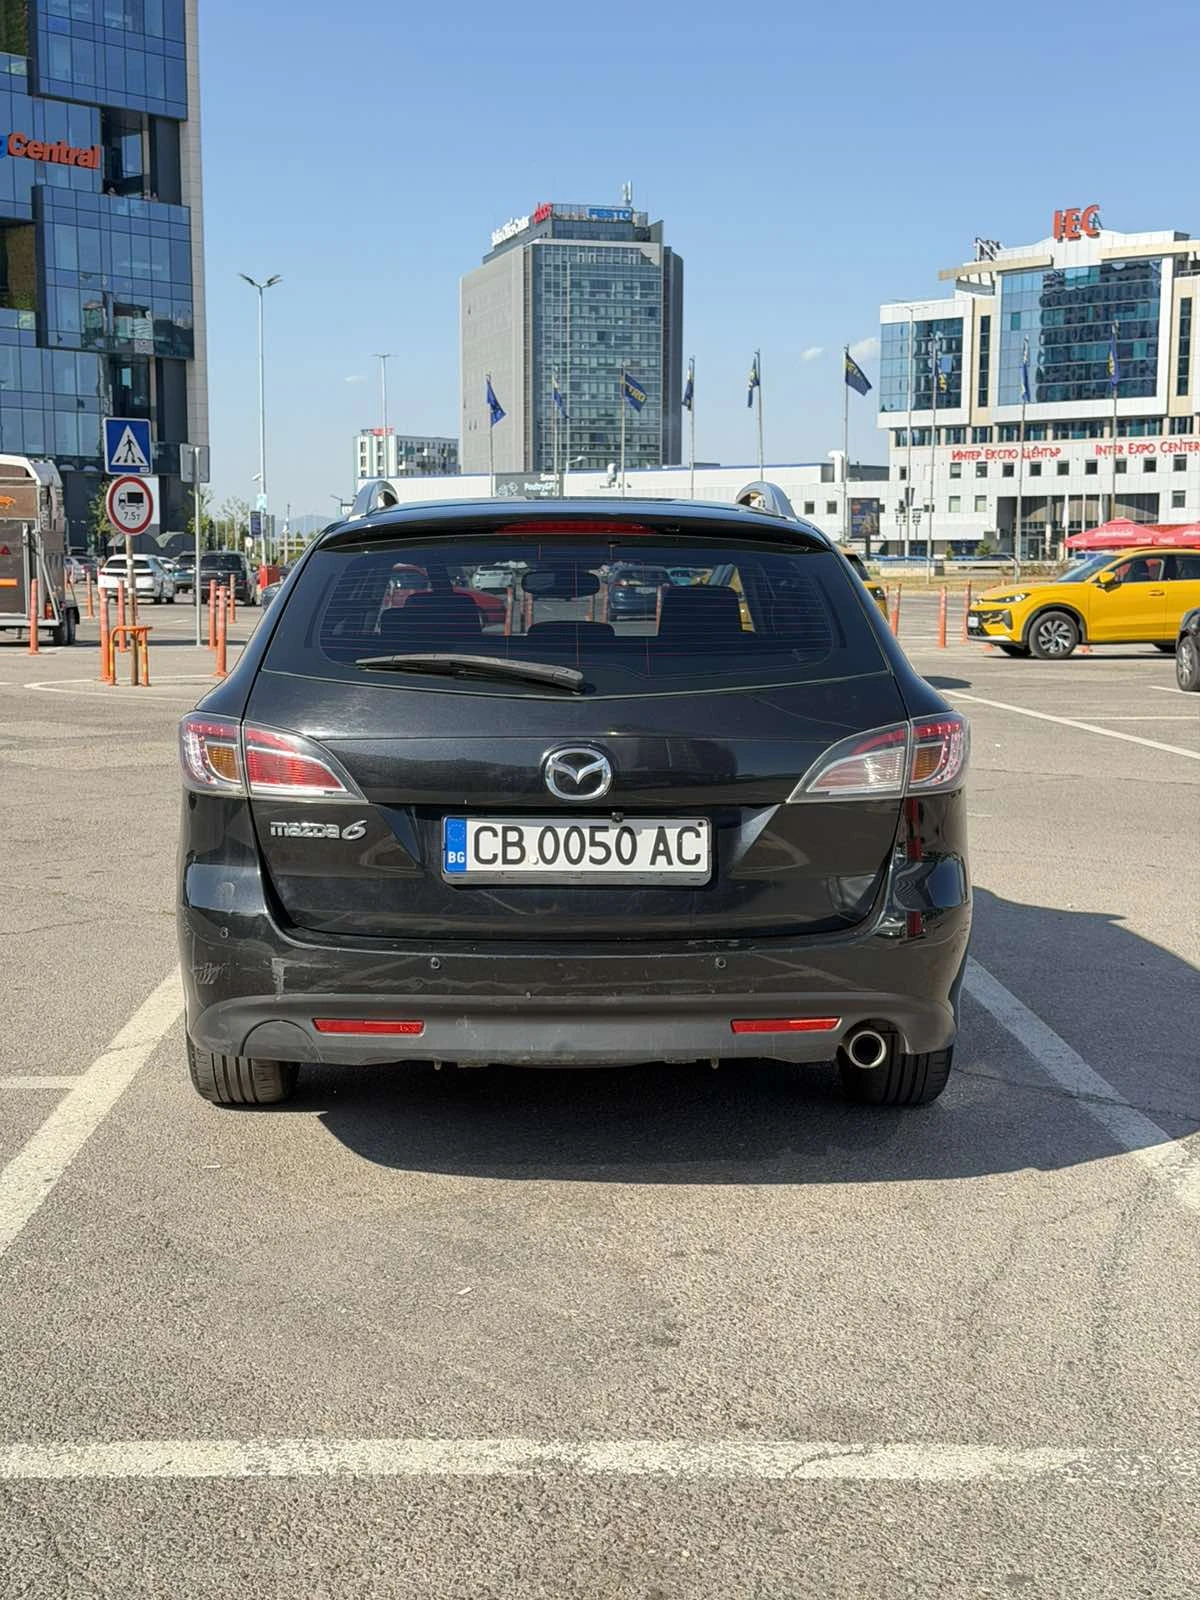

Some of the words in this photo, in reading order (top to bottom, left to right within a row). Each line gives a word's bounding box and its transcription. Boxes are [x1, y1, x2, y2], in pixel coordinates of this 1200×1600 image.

[8, 132, 101, 169] Central
[1053, 204, 1101, 242] IEC
[447, 851, 465, 864] BG
[474, 825, 526, 865] CB
[537, 825, 637, 866] 0050
[649, 825, 702, 866] AC
